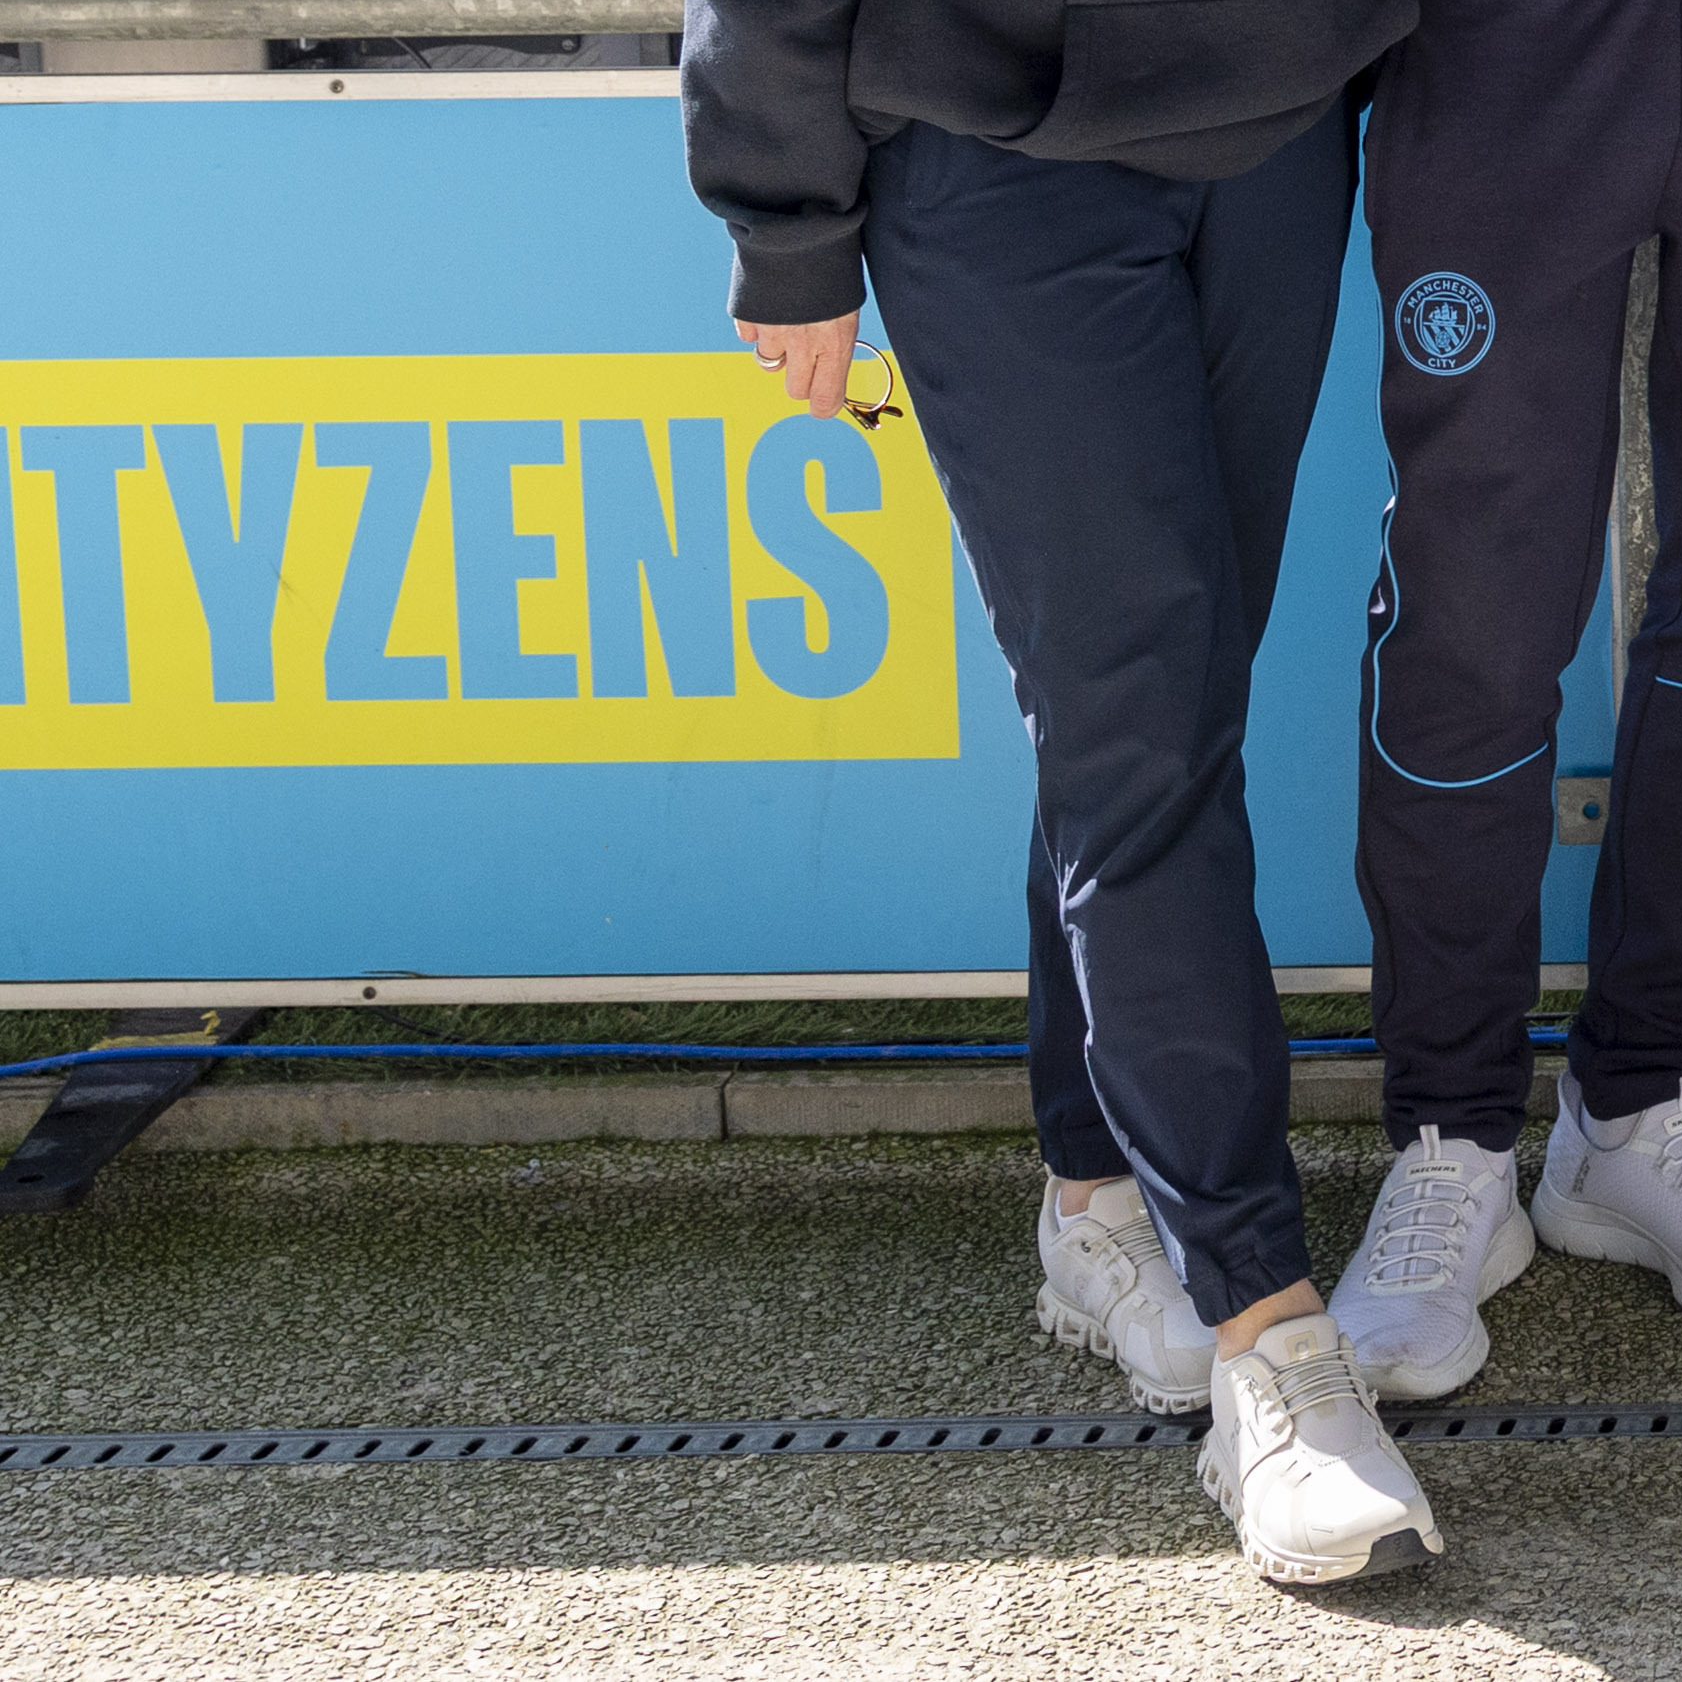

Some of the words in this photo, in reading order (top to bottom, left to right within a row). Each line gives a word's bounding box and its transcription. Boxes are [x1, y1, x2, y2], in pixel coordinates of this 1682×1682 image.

[1407, 280, 1484, 315] MANCHESTER
[1428, 358, 1456, 368] CITY
[1410, 1165, 1456, 1175] SKECHERS
